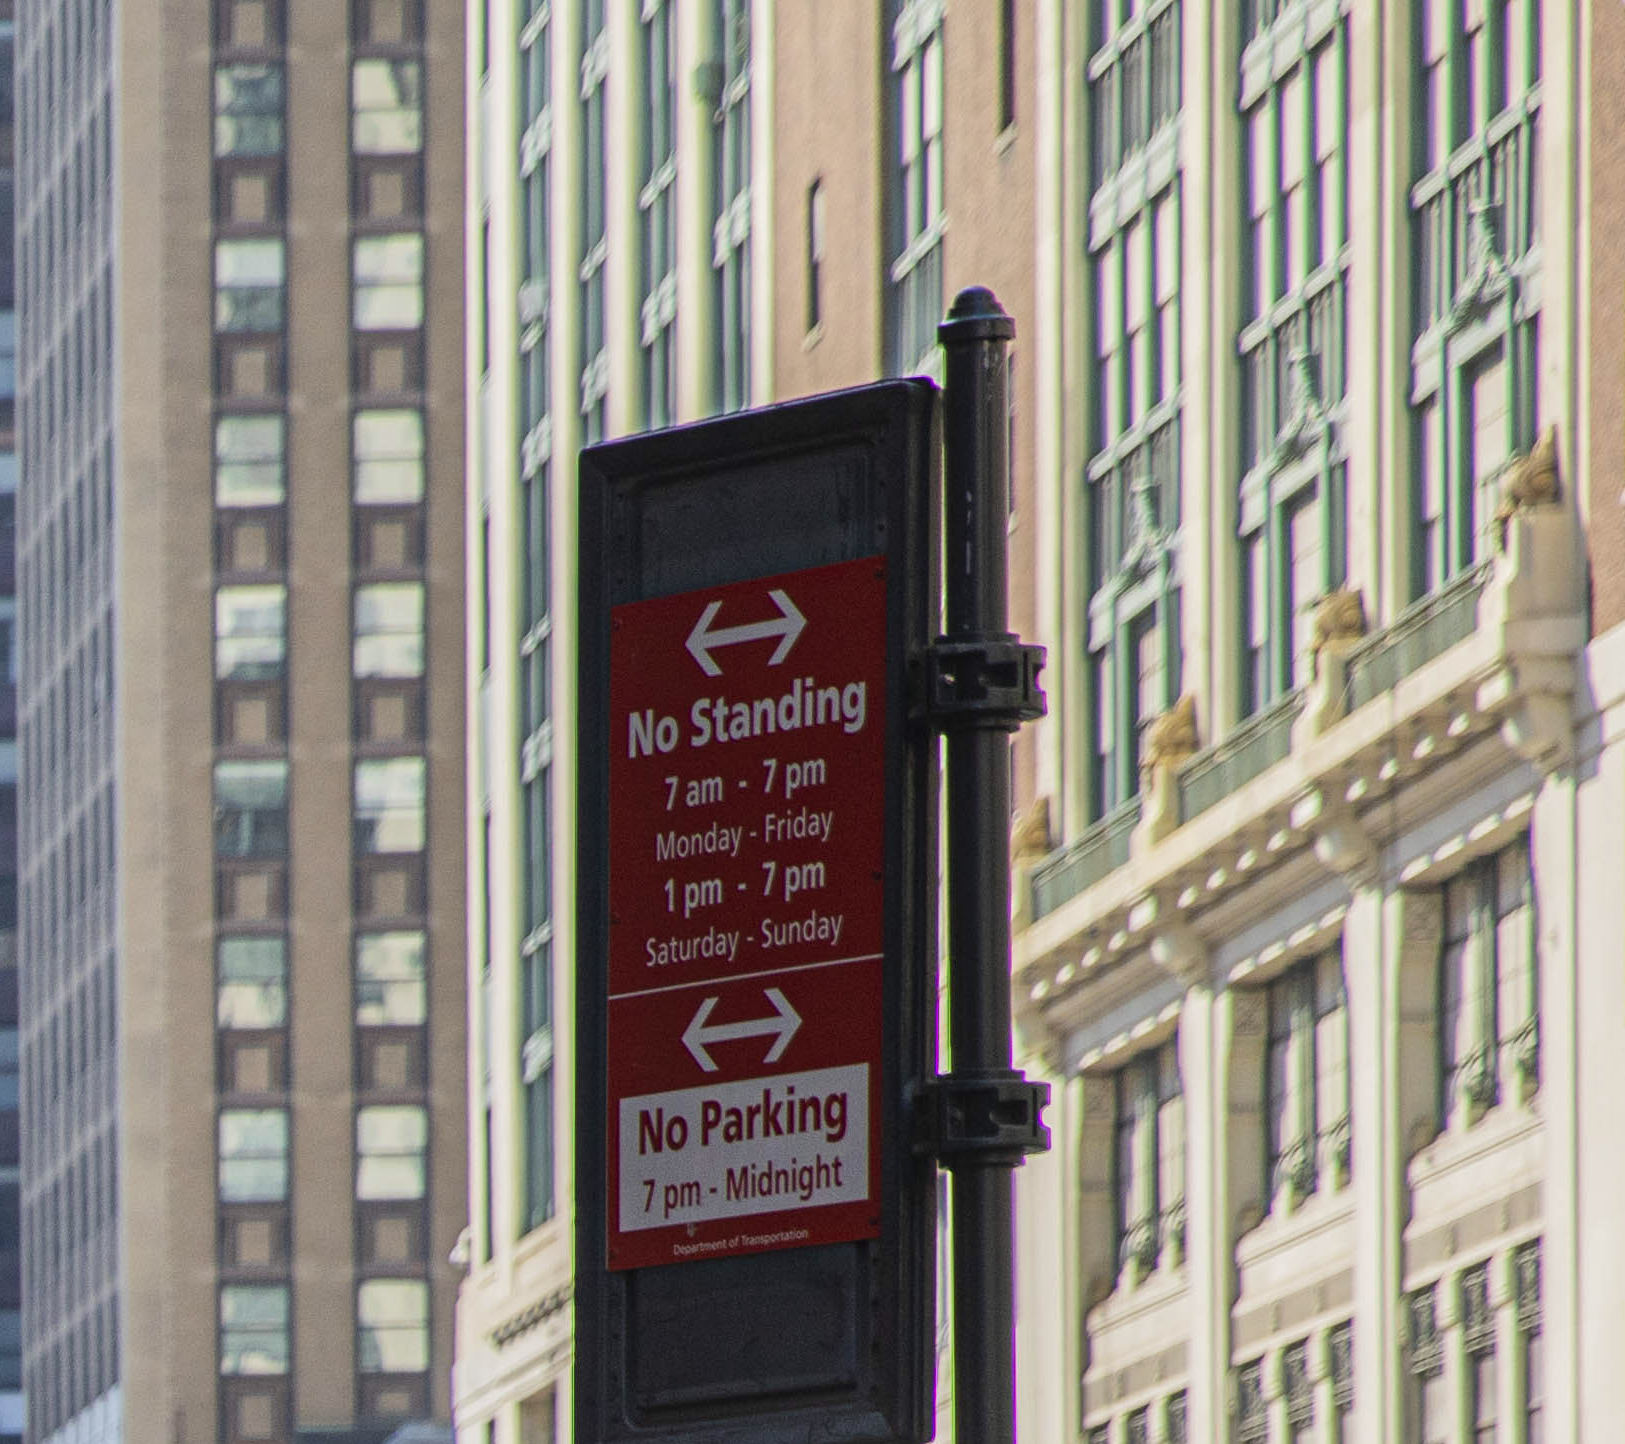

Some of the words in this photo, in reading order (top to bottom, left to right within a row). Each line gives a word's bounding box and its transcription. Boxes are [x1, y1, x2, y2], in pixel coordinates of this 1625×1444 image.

[628, 709, 678, 758] No
[690, 677, 866, 747] Standing
[665, 776, 678, 811] 7
[685, 776, 723, 807] am
[763, 758, 777, 793] 7
[785, 758, 825, 799] pm
[656, 822, 742, 861] Monday
[765, 806, 833, 843] Friday
[664, 878, 674, 912] 1
[684, 878, 723, 919] pm
[762, 861, 776, 896] 7
[785, 860, 825, 901] pm
[646, 927, 739, 967] Saturday
[761, 910, 843, 948] Sunday
[638, 1107, 688, 1155] No
[701, 1085, 848, 1146] Parking
[643, 1179, 655, 1212] 7
[664, 1179, 701, 1219] pm
[726, 1154, 842, 1202] Midnight
[674, 1239, 726, 1255] Department
[728, 1237, 739, 1249] of
[741, 1229, 808, 1247] Transportation
